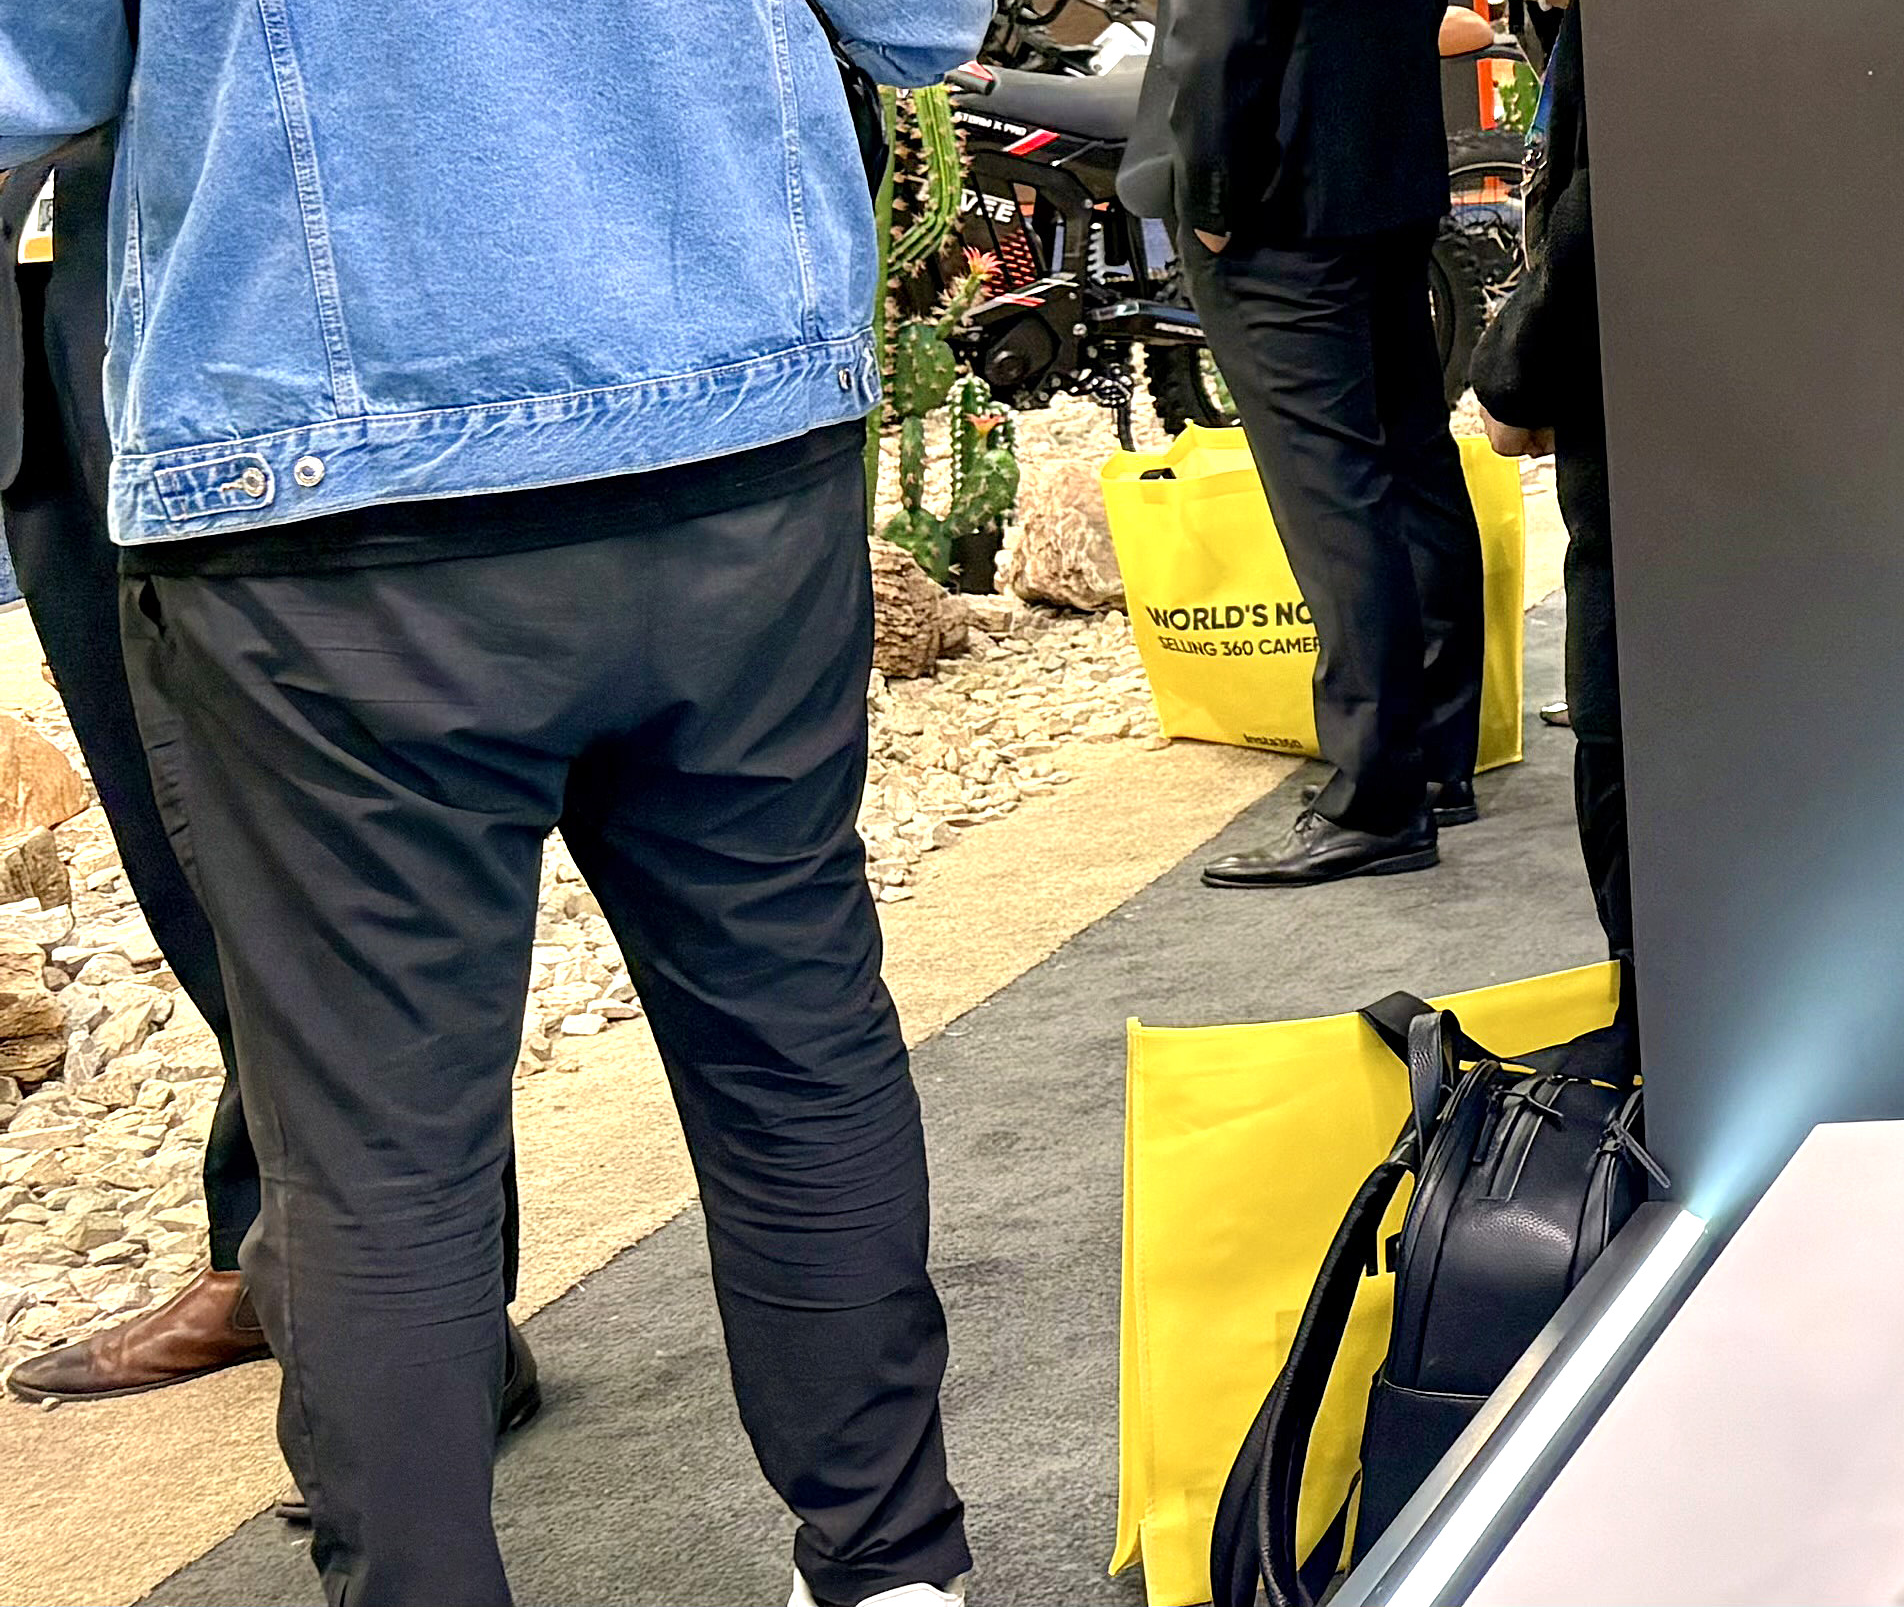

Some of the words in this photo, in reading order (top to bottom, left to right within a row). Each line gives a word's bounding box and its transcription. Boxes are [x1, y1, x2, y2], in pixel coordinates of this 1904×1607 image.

[1145, 603, 1269, 632] WORLD'S
[1158, 635, 1218, 656] SELLING
[1221, 640, 1254, 657] 360
